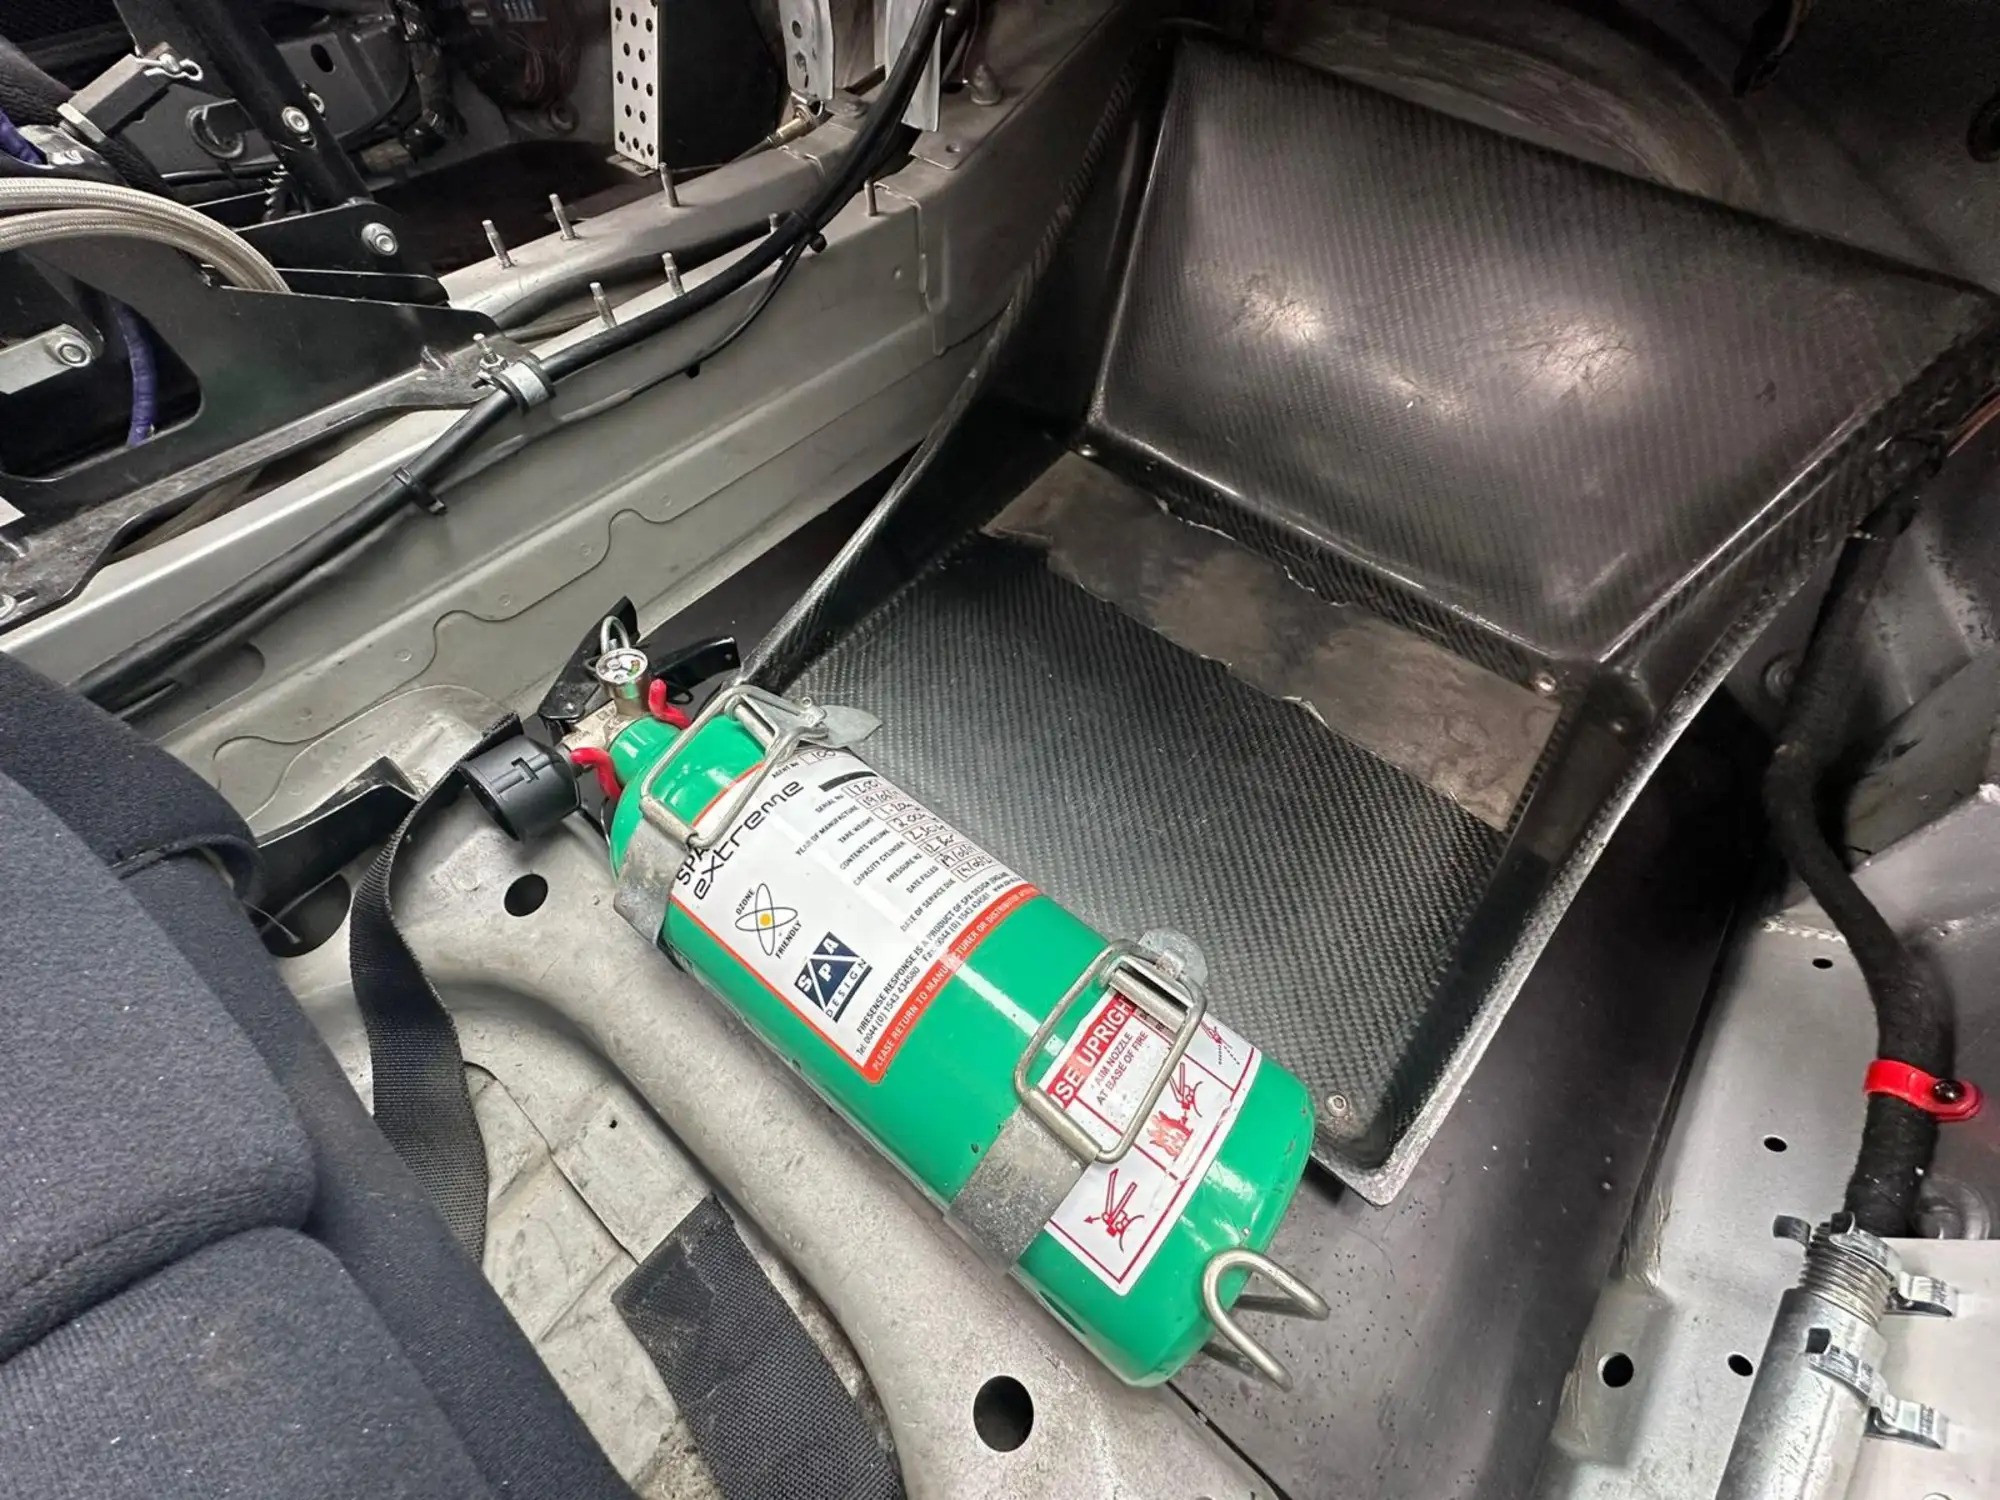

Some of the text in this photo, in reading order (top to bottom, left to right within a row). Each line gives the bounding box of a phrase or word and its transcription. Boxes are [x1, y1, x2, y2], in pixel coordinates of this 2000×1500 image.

[796, 805, 859, 856] YEAR OF MANUFACTURE
[815, 798, 836, 813] SERIAL
[853, 816, 874, 832] WEIGHT
[694, 779, 804, 900] extreme
[839, 828, 890, 871] CONTENTS VOLUME
[853, 840, 906, 886] CAPACITY CYLINDER
[886, 858, 915, 883] PRESSURE
[906, 864, 939, 894] DATE FILLED
[735, 888, 755, 915] OZONE
[900, 878, 956, 932] DATE OF SERVICE DUE
[775, 920, 802, 959] FRIENDLY
[825, 958, 867, 1018] DESIGN
[857, 993, 886, 1035] FIRESENSE
[884, 953, 916, 995] RESPONSE
[913, 944, 923, 956] IS
[921, 939, 929, 947] A
[926, 910, 955, 941] PRODUCT
[952, 903, 963, 913] OF
[863, 1025, 878, 1044] 0044
[884, 993, 900, 1012] 1543
[872, 1039, 894, 1071] PLEASE
[891, 1004, 919, 1039] RETURN
[916, 990, 928, 1004] TO
[976, 920, 988, 933] OR
[1077, 1001, 1133, 1067] UPRIGH
[1094, 1032, 1133, 1087] AIM NOZZLE
[1097, 1090, 1108, 1105] AT
[1105, 1062, 1127, 1091] BASE
[1123, 1049, 1136, 1065] OF
[1132, 1031, 1148, 1051] FIRE
